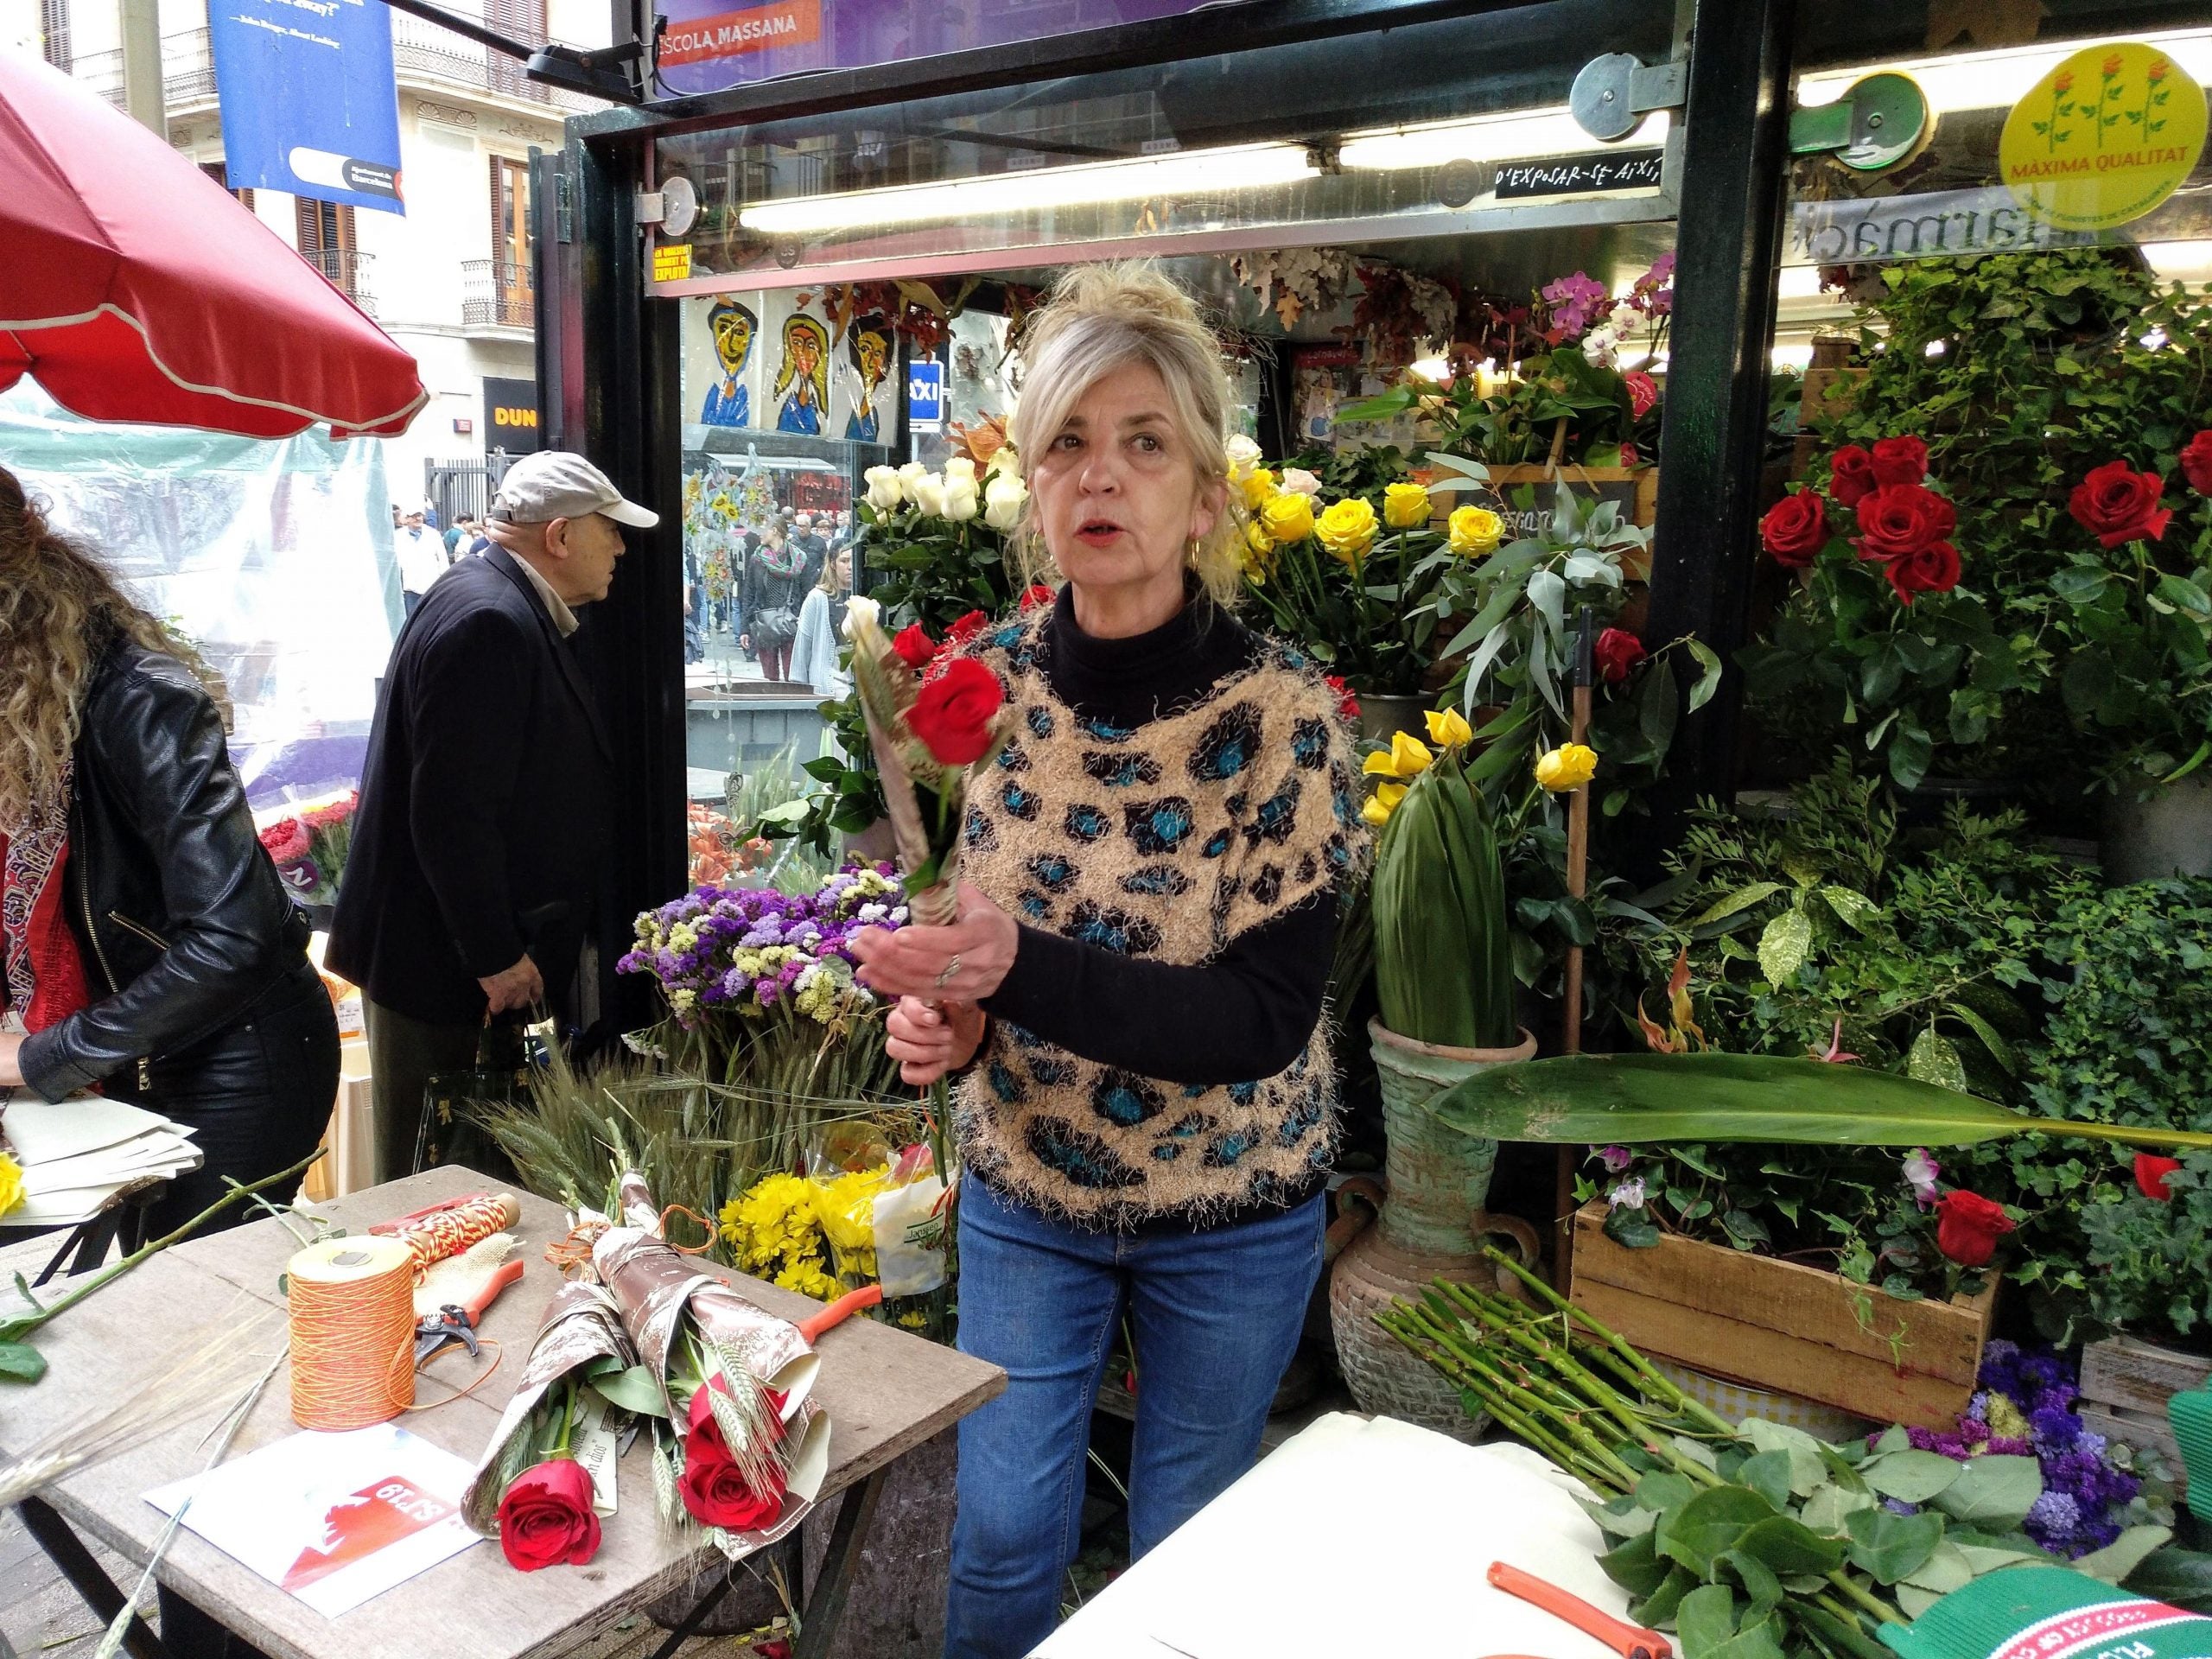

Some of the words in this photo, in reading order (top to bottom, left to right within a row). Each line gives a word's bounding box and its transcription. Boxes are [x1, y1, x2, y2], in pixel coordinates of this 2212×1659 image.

[717, 14, 797, 45] MASSANA
[2010, 157, 2090, 179] MÀXIMA
[2095, 146, 2189, 172] QUALITAT
[909, 1222, 938, 1239] Janssen
